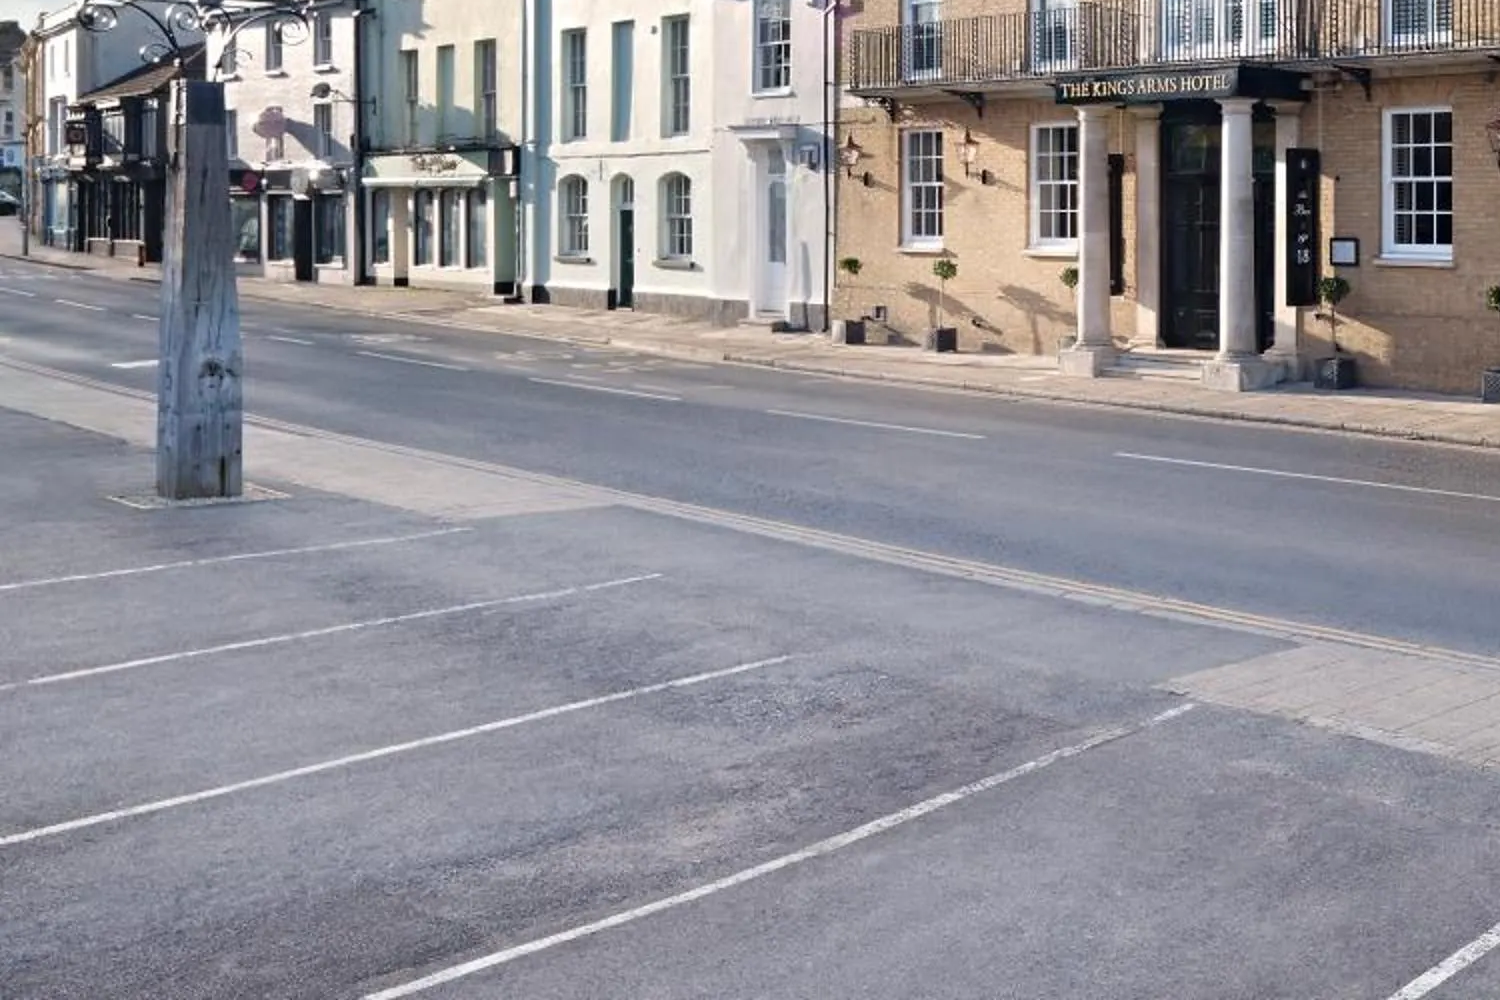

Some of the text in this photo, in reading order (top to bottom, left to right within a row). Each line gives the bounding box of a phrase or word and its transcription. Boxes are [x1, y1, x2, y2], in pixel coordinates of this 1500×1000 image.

[1061, 74, 1231, 98] THE KINGS ARMS HOTEL
